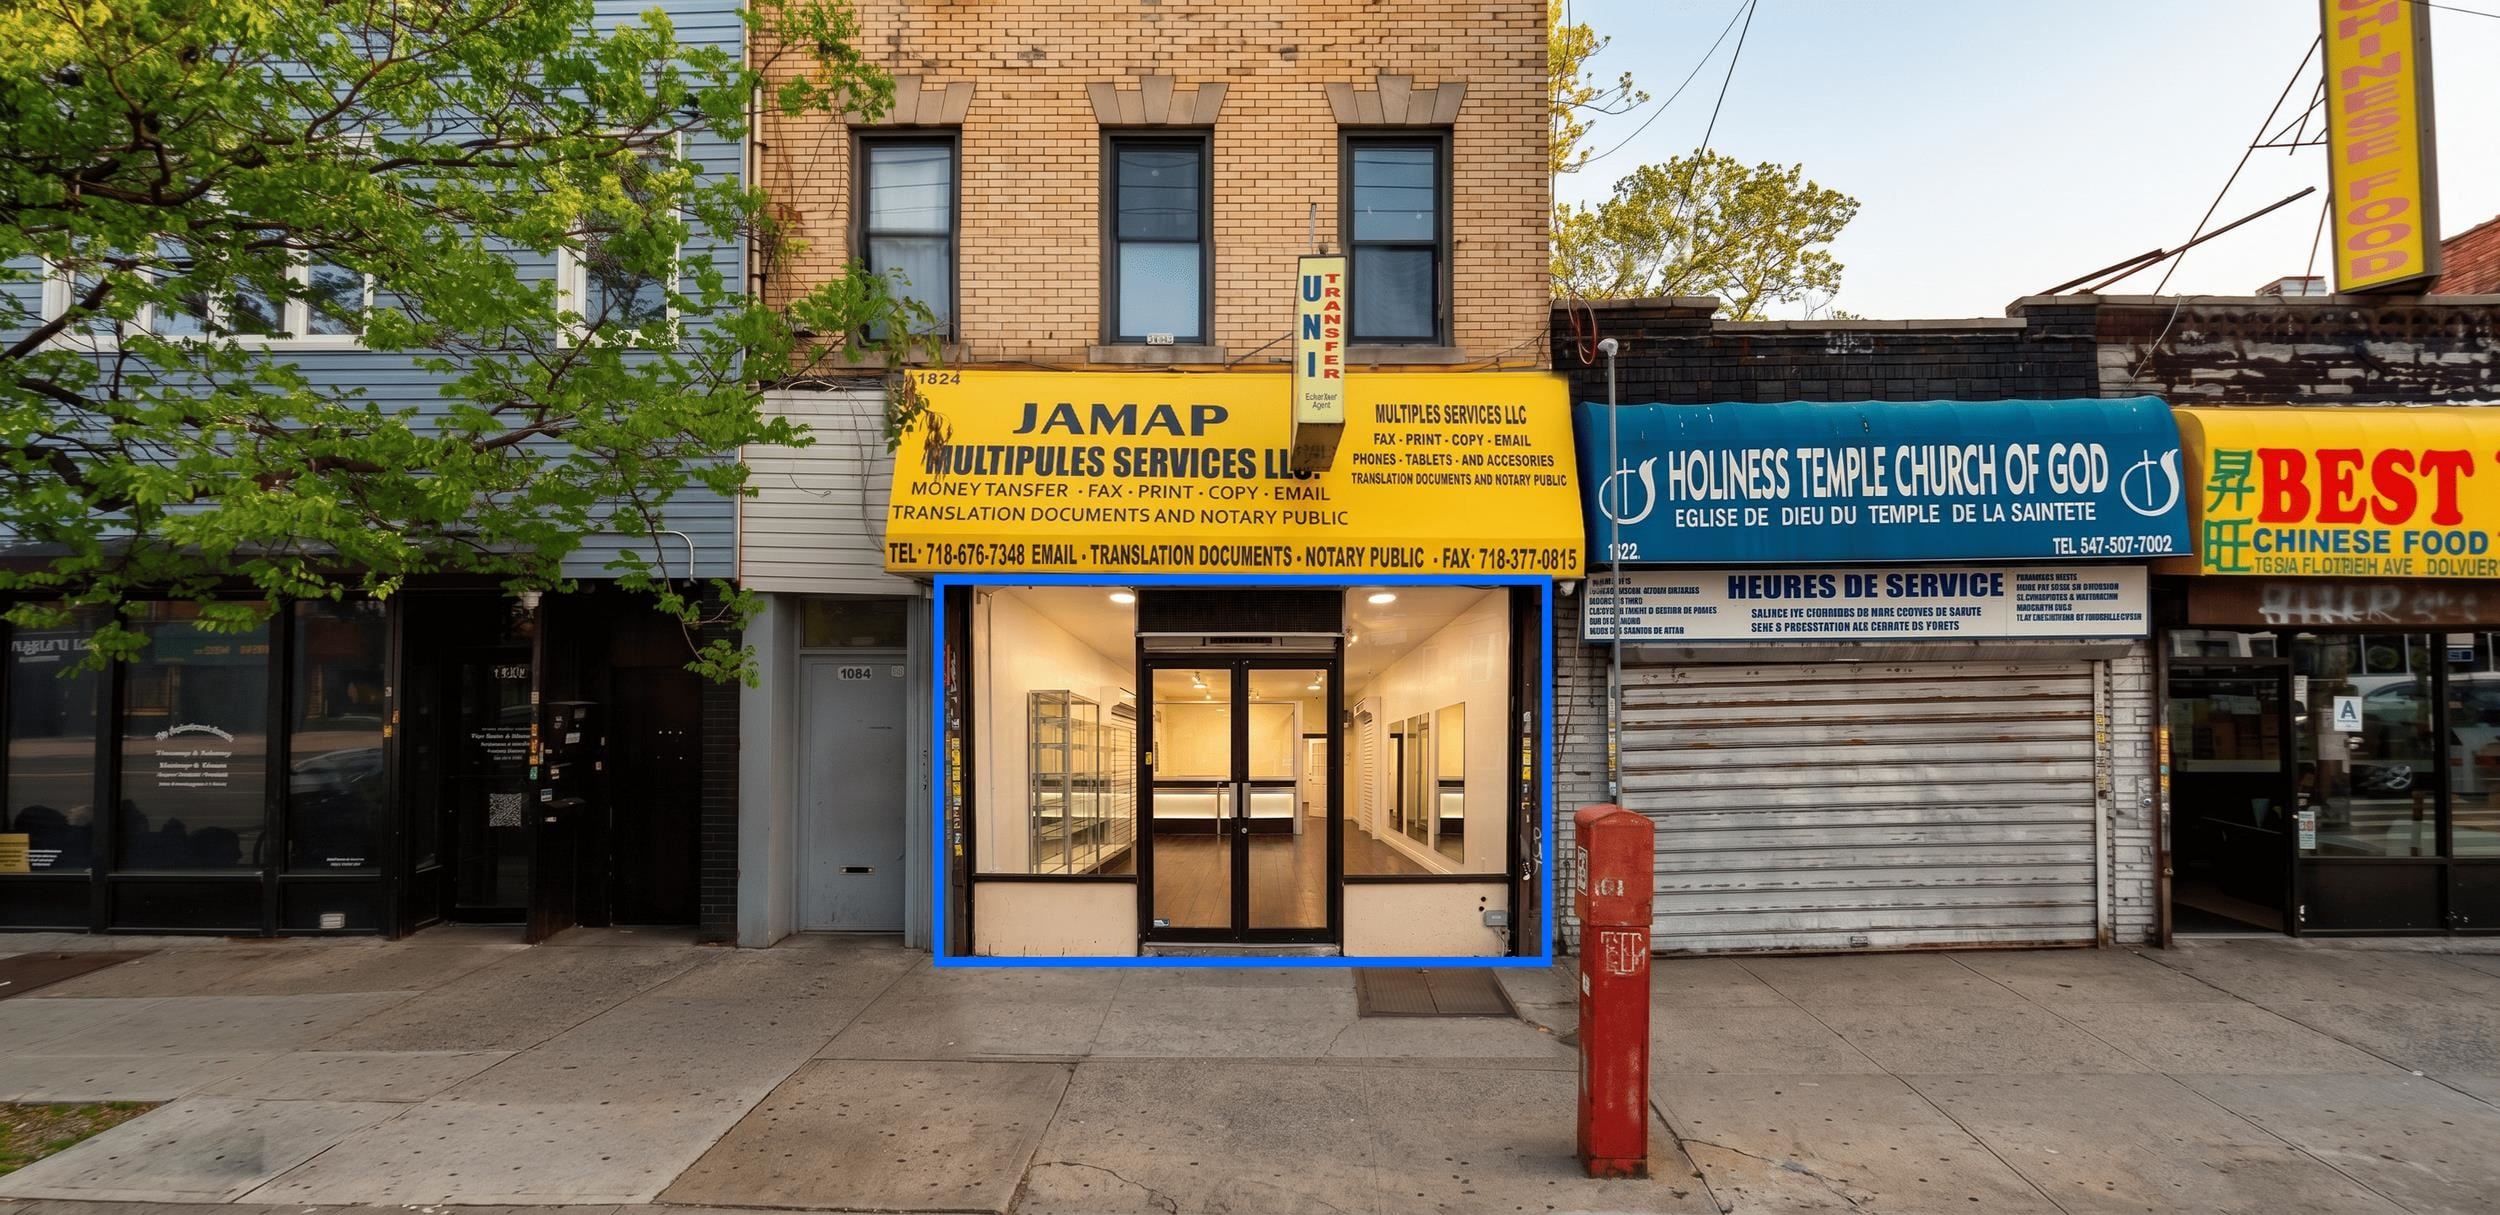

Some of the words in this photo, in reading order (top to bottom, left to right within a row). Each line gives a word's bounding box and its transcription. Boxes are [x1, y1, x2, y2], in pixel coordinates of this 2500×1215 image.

[1324, 273, 1340, 379] TRANSFER
[918, 373, 961, 385] 1824
[1012, 402, 1229, 436] JAMAP
[1375, 404, 1441, 424] MULTIPLES
[1444, 405, 1501, 424] SERVICES
[1505, 405, 1527, 424] LLC
[1373, 433, 1395, 445] FAX
[1406, 433, 1442, 446] PRINT
[1451, 434, 1484, 446] COPY
[1494, 435, 1531, 447] EMAIL
[925, 445, 1105, 477] MULTIPULES
[1113, 447, 1256, 480] SERVICES
[1352, 453, 1396, 465] PHONES
[1405, 454, 1452, 466] TABLETS
[1461, 455, 1484, 467] AND
[1487, 455, 1554, 467] ACCESORIES
[1351, 472, 1413, 485] TRANSLATION
[1416, 473, 1471, 486] DOCUMENTS
[1474, 474, 1492, 486] AND
[1495, 474, 1531, 486] NOTARY
[1534, 474, 1567, 487] PUBLIC
[1668, 448, 1790, 501] HOLINESS
[1796, 446, 1889, 498] TEMPLE
[1895, 444, 1997, 497] CHURCH
[2005, 443, 2039, 495] OF
[2048, 443, 2109, 495] GOD
[911, 482, 981, 496] MONEY
[985, 482, 1068, 497] TANSFER
[1088, 484, 1124, 498] FAX
[1138, 485, 1194, 499] PRINT
[1208, 486, 1258, 500] COPY
[1274, 487, 1331, 501] EMAIL
[2257, 448, 2474, 526] BEST
[892, 505, 1025, 521] TRANSLATION
[1031, 507, 1150, 522] DOCUMENTS
[1154, 509, 1195, 523] AND
[1200, 509, 1278, 524] NOTARY
[1283, 511, 1348, 525] PUBLIC
[1675, 508, 1738, 528] EGLISE
[1744, 507, 1769, 527] DE
[1782, 506, 1824, 526] DIEU
[1831, 505, 1857, 525] DU
[1868, 504, 1940, 524] TEMPLE
[1953, 504, 1976, 523] DE
[1983, 503, 2006, 522] LA
[2011, 502, 2096, 522] SAINTETE
[2053, 537, 2077, 555] TEL
[2080, 535, 2173, 554] 547-507-7002
[2253, 528, 2391, 554] CHINESE
[2404, 530, 2489, 555] FOOD
[926, 543, 1025, 565] 718-676-7348
[1032, 544, 1077, 565] EMAIL
[1090, 544, 1194, 566] TRANSLATION
[1199, 545, 1292, 567] DOCUMENTS
[1305, 546, 1365, 567] NOTARY
[1370, 547, 1424, 568] PUBLIC
[1479, 548, 1577, 570] 718-377-0815
[2383, 558, 2412, 575] AVE
[1727, 574, 1837, 600] HEURES
[1844, 573, 1878, 599] DE
[1886, 572, 2004, 598] SERVICE
[841, 668, 872, 680] 1084
[2340, 700, 2356, 720] A
